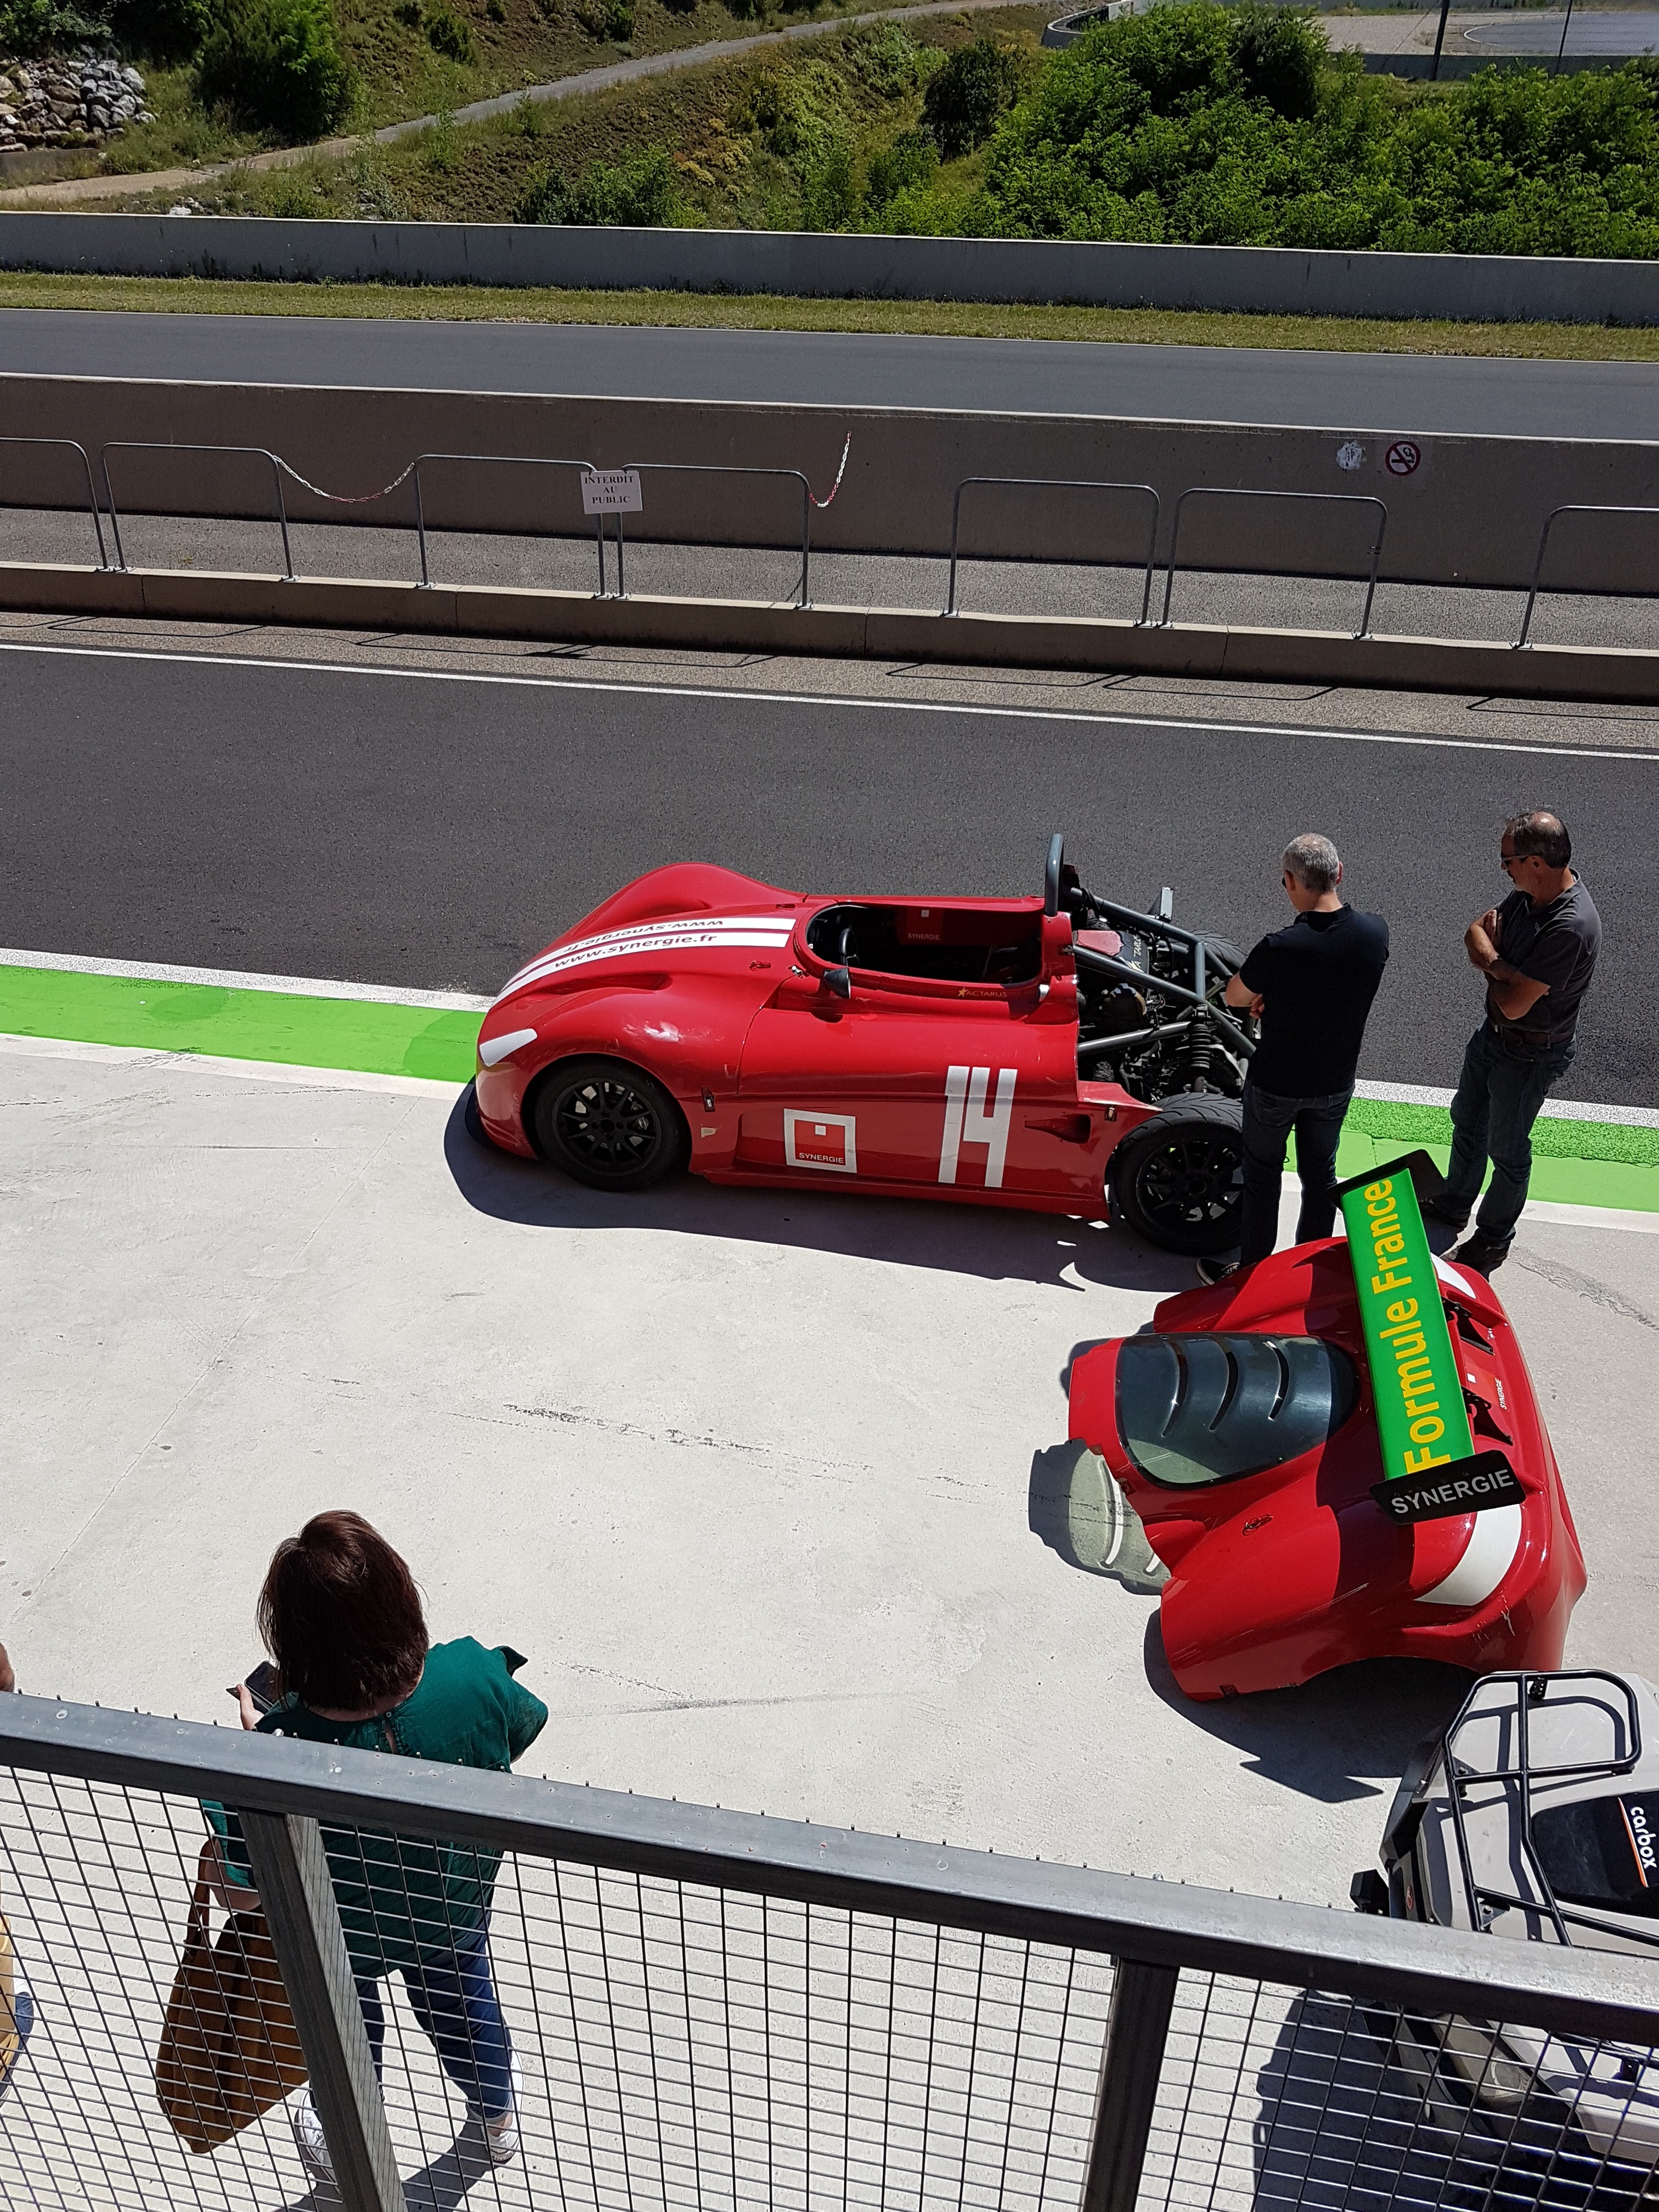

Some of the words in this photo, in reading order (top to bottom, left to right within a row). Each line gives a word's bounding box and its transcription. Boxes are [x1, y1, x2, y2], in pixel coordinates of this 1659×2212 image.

[585, 476, 634, 484] INTERDIT
[555, 934, 717, 968] www.synergie.fr
[564, 919, 723, 952] www.synergie.fr
[938, 1065, 1018, 1187] 14
[799, 1152, 844, 1164] SYNERGIE
[1364, 1178, 1412, 1294] France
[1379, 1297, 1451, 1474] Formule
[1494, 1378, 1507, 1410] SYNERGIE
[1391, 1469, 1514, 1514] SYNERGIE
[1630, 1807, 1657, 1869] carbox
